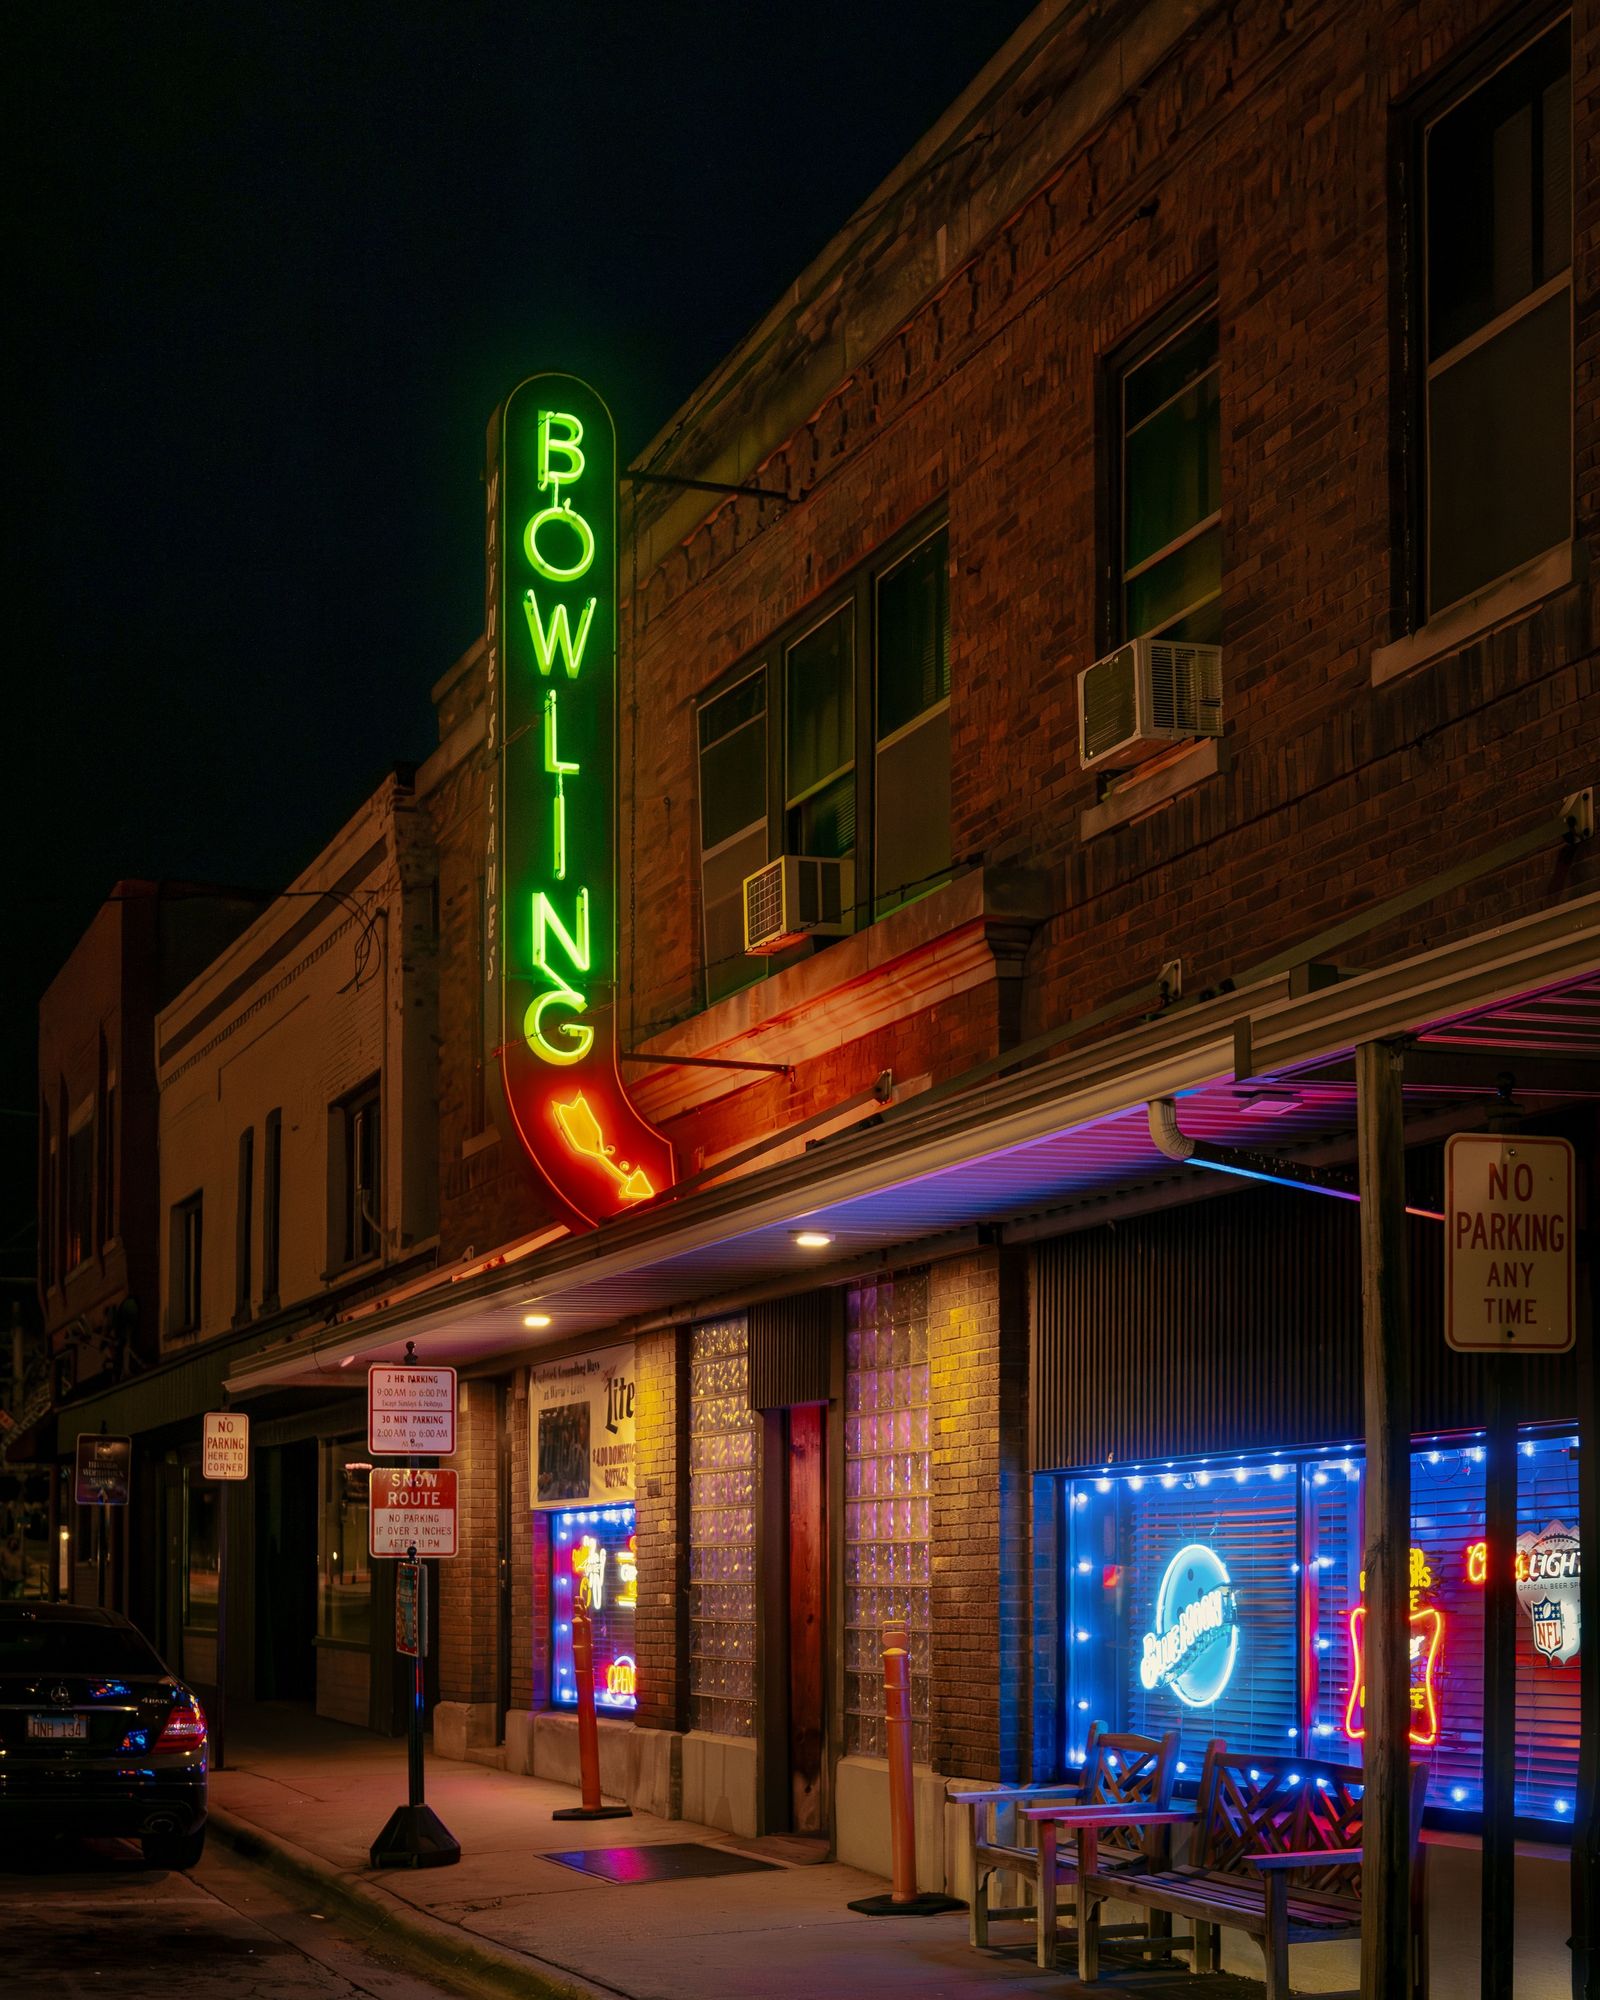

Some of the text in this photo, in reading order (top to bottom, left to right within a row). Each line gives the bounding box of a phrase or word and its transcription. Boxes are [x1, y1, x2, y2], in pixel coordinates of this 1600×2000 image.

[523, 409, 597, 1066] BOWLING
[486, 783, 497, 982] LANES
[1488, 1162, 1534, 1202] NO
[1456, 1211, 1565, 1253] PARKING
[1486, 1261, 1535, 1288] ANY
[1483, 1298, 1538, 1324] TIME
[394, 1375, 405, 1383] HR
[408, 1376, 438, 1384] PARKING
[377, 1388, 393, 1396] 9:00
[394, 1388, 406, 1397] AM
[419, 1389, 435, 1397] 6:00
[436, 1389, 448, 1397] PM
[604, 1377, 635, 1434] Lite
[218, 1420, 234, 1433] NO
[413, 1416, 444, 1424] PARKING
[377, 1429, 393, 1437] 2:00
[394, 1429, 406, 1437] AM
[419, 1430, 435, 1438] 6:00
[207, 1437, 244, 1450] PARKING
[208, 1452, 244, 1461] HERE TO
[208, 1462, 243, 1472] CORNER
[392, 1473, 438, 1488] SNOW
[388, 1492, 441, 1506] ROUTE
[389, 1514, 440, 1523] NO PARKING
[376, 1527, 452, 1536] IF OVER 3 INCHES
[389, 1540, 440, 1548] AFTER 11 PM
[1529, 1551, 1581, 1578] LIGH
[1536, 1622, 1561, 1649] NFL
[608, 1665, 636, 1694] OPEN
